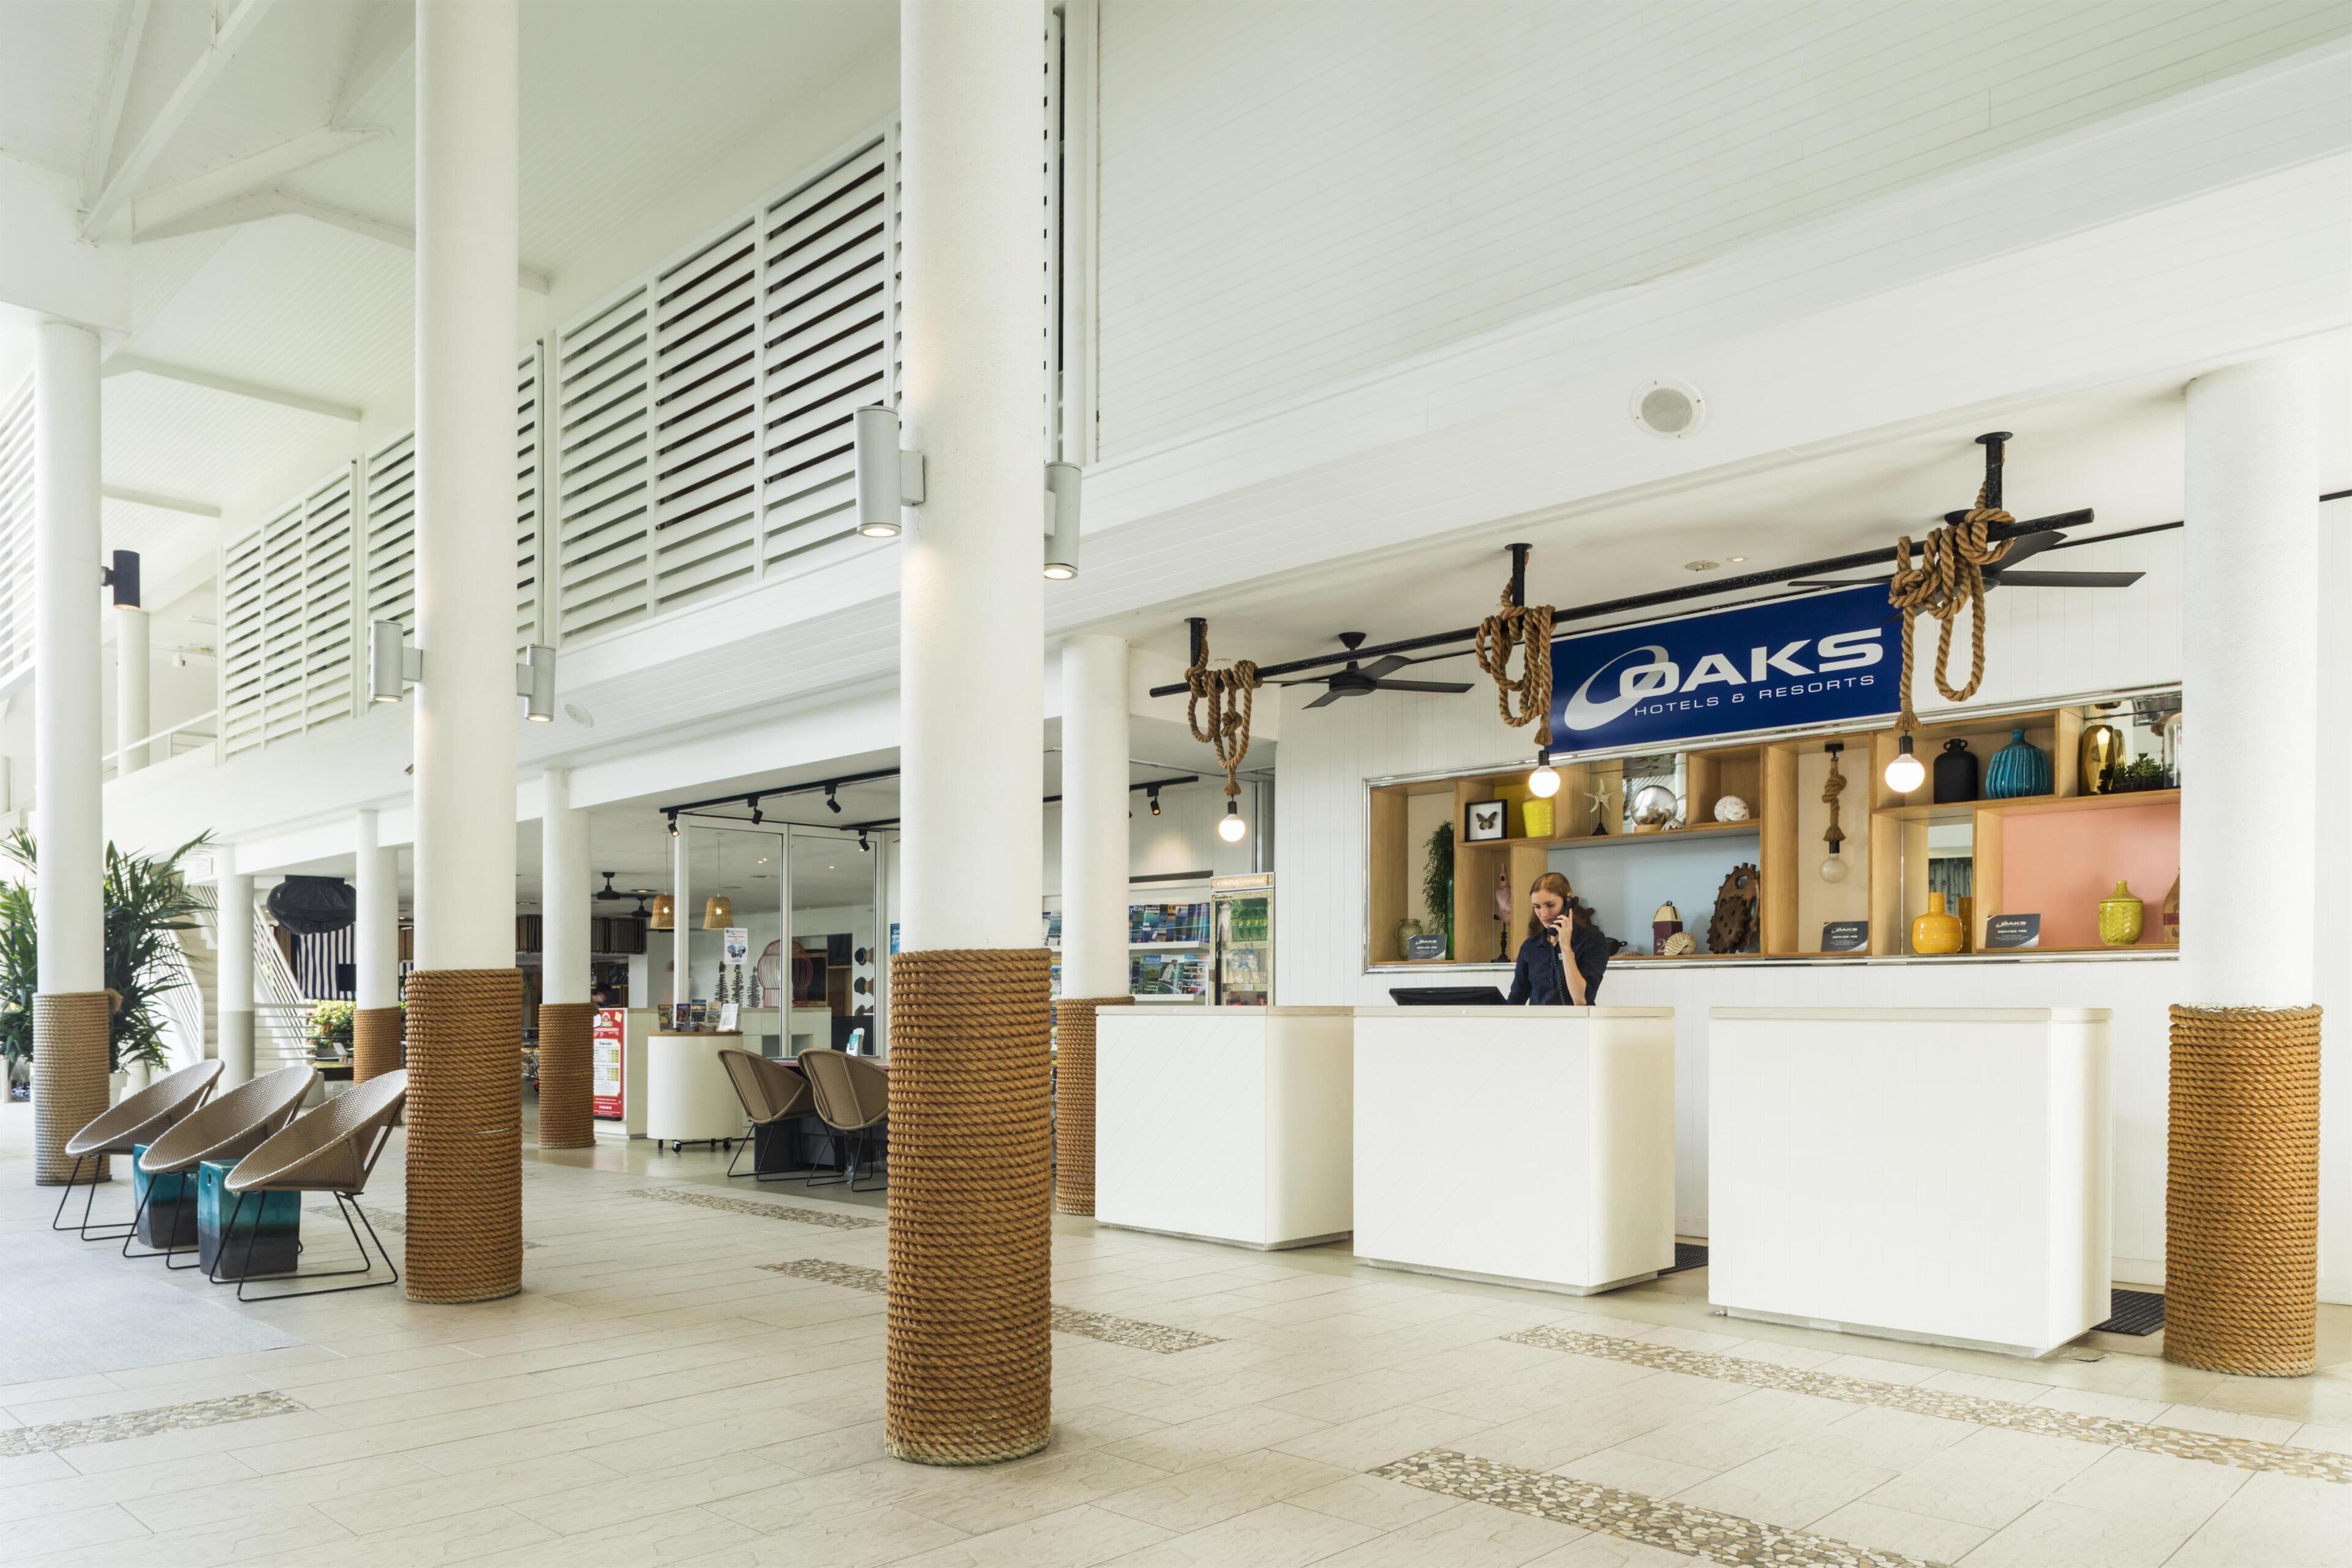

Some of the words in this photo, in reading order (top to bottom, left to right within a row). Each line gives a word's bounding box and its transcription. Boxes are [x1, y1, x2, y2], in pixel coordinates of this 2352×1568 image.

[1619, 627, 1883, 700] OAKS
[1634, 696, 1719, 717] HOTELS
[1732, 693, 1745, 703] &
[1759, 675, 1875, 699] RESORTS
